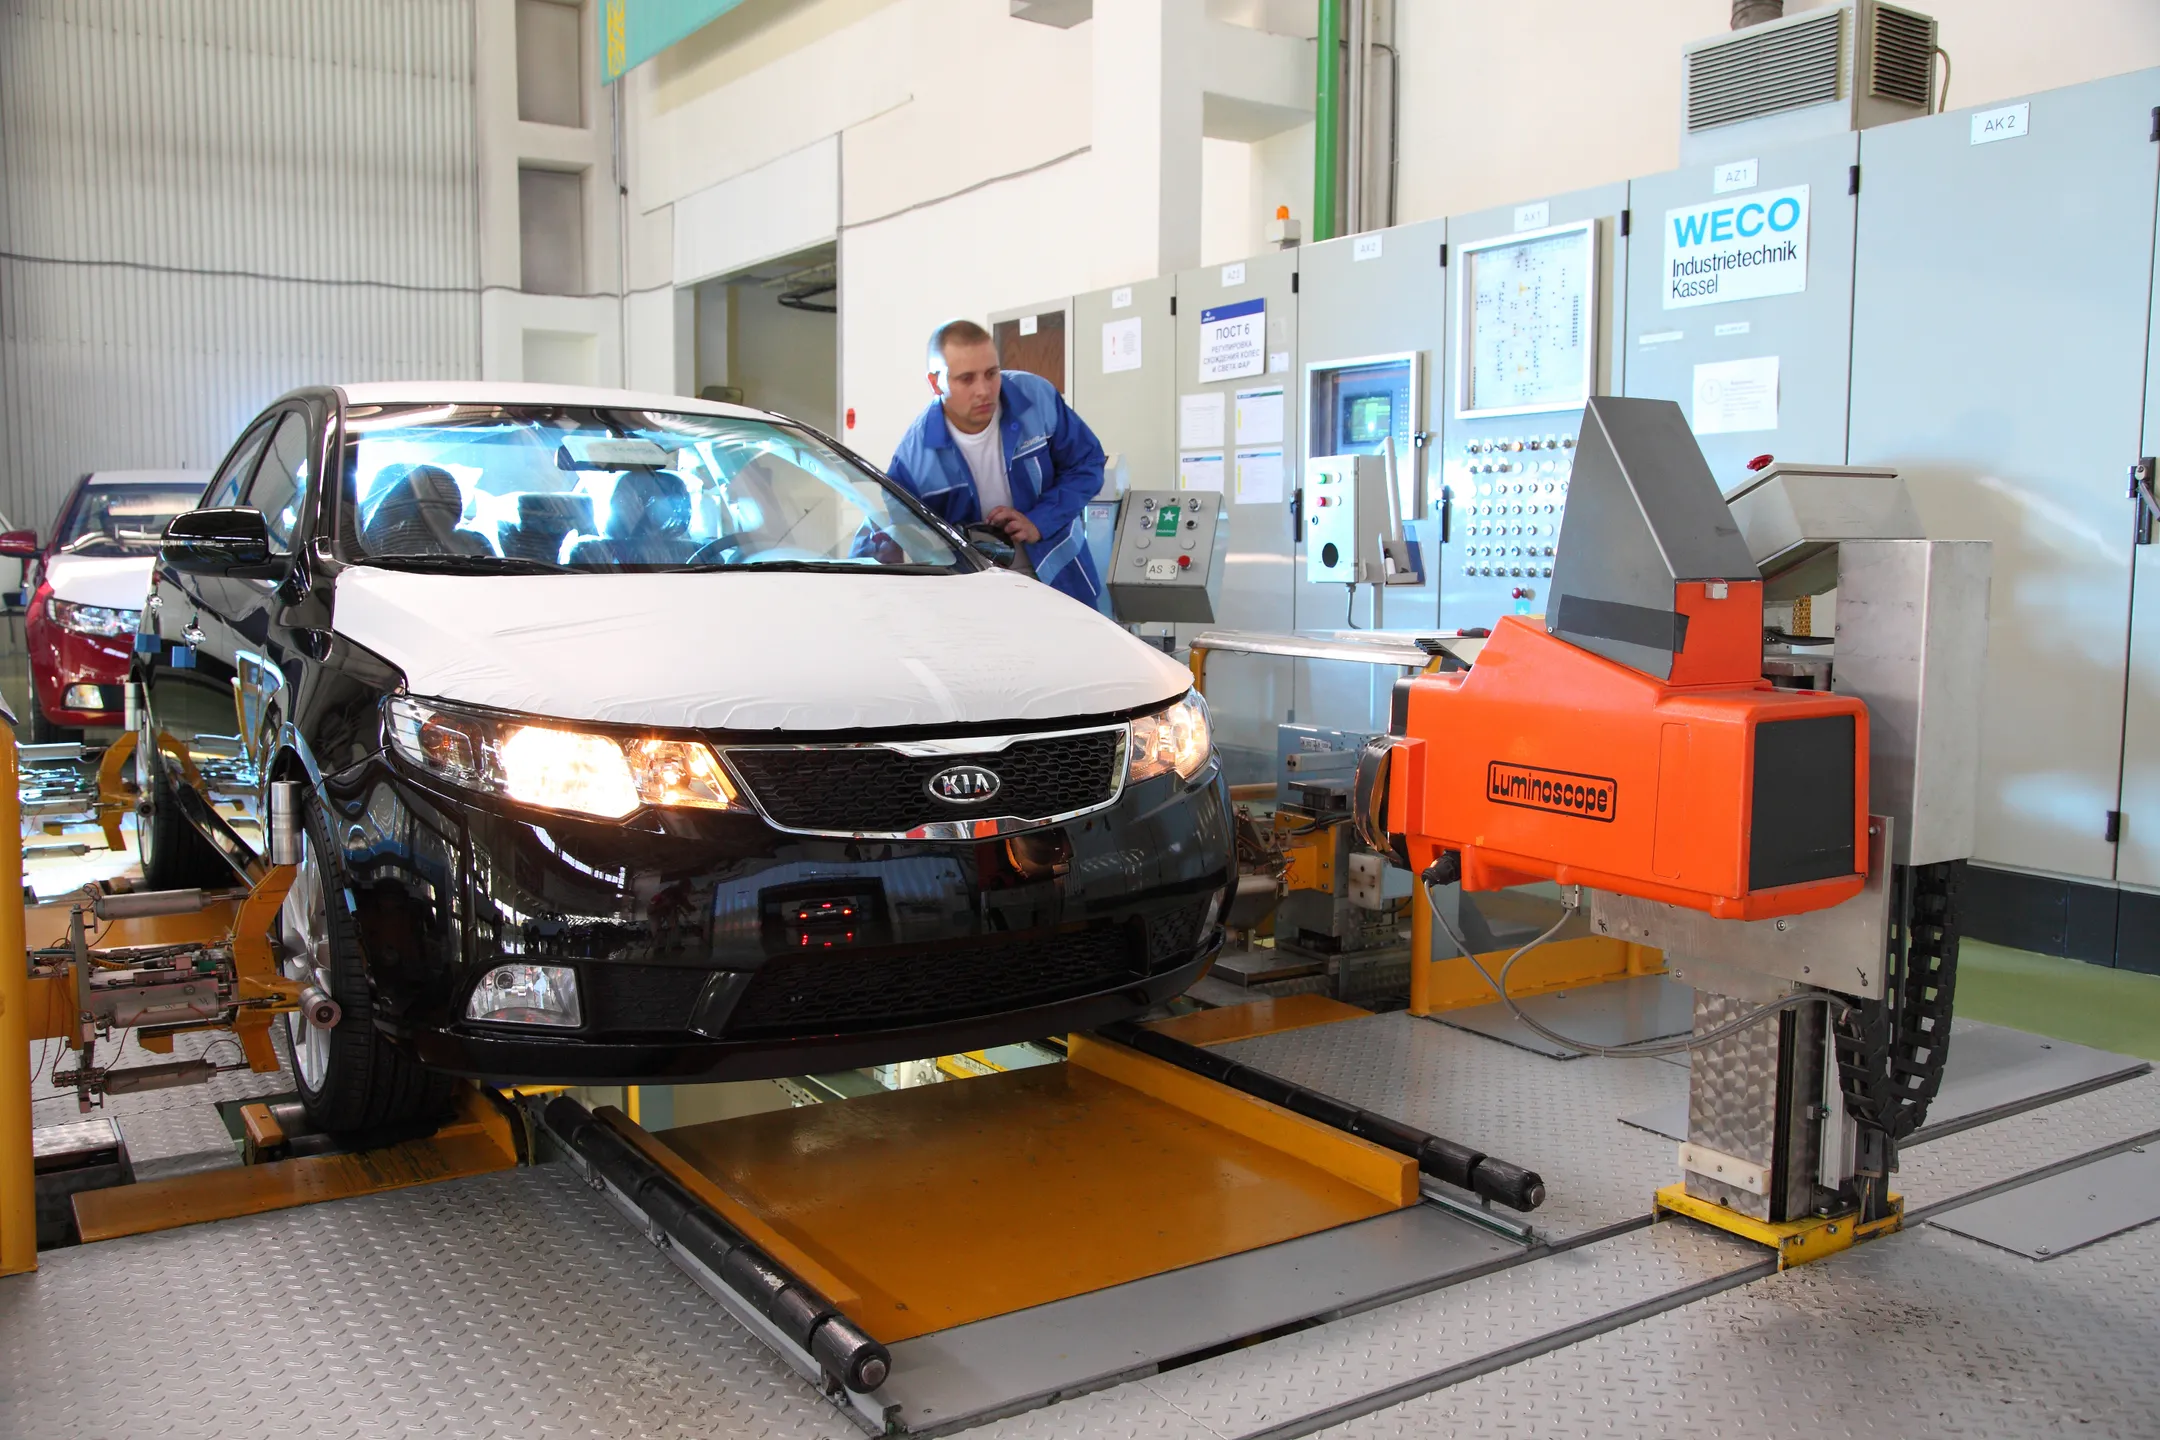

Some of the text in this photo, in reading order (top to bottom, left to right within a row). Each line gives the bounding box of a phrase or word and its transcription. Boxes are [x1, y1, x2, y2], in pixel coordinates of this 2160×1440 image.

[1984, 115, 2016, 133] AK 2
[1725, 169, 1748, 183] AZ1
[1673, 197, 1801, 249] WECO
[1672, 240, 1797, 278] Industrietechnik
[1672, 274, 1719, 299] Kassel
[1215, 323, 1250, 341] ПОСТ 6
[1211, 340, 1253, 354] РЕГУЛИРОВКА
[1148, 564, 1176, 575] AS 3
[941, 773, 992, 796] KIA
